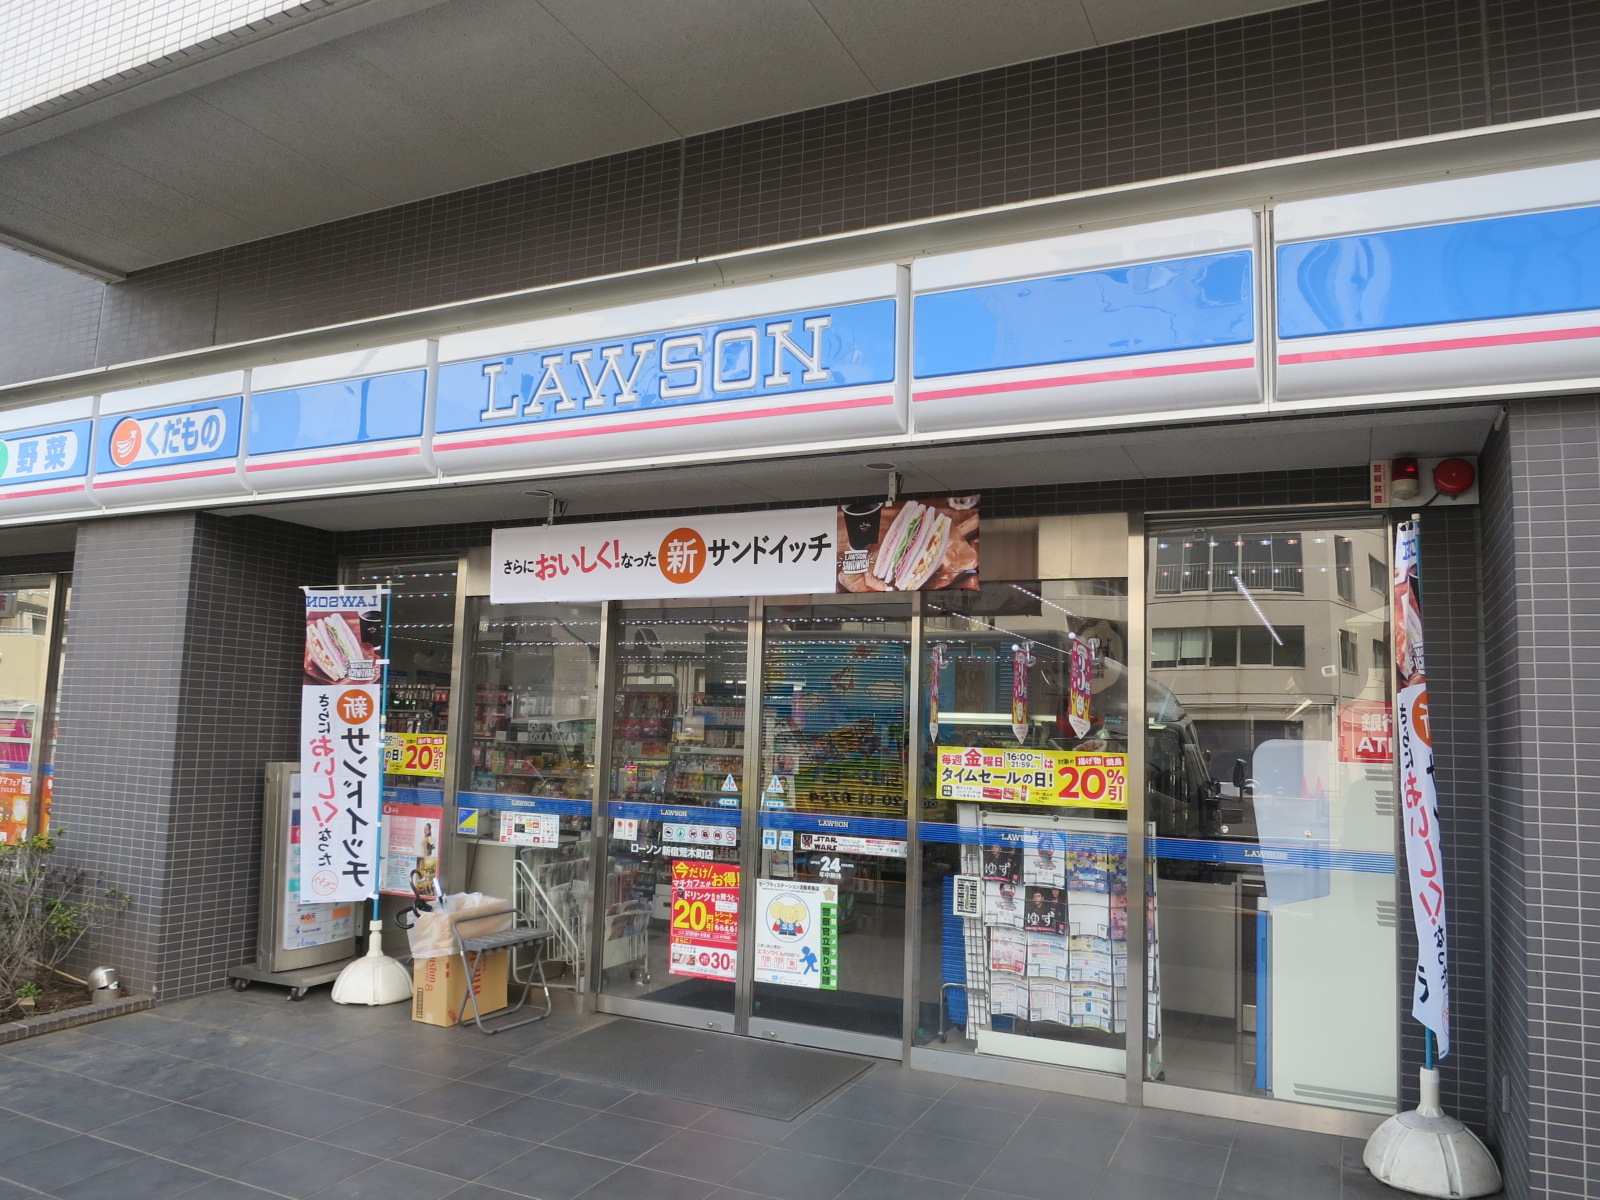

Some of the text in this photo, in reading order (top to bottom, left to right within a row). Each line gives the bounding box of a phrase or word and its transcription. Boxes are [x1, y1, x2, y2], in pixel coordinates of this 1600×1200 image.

[480, 314, 832, 422] LAWSON
[146, 414, 221, 456] くだもの
[16, 436, 67, 473] 野菜
[666, 537, 696, 575] 新
[707, 533, 832, 567] サンドイッチ
[1357, 736, 1392, 753] AT
[660, 809, 688, 817] LAWSON
[818, 819, 849, 828] LAWSON
[813, 836, 838, 844] STAR
[813, 844, 838, 852] WARS
[820, 855, 842, 873] 24
[428, 957, 438, 983] nston
